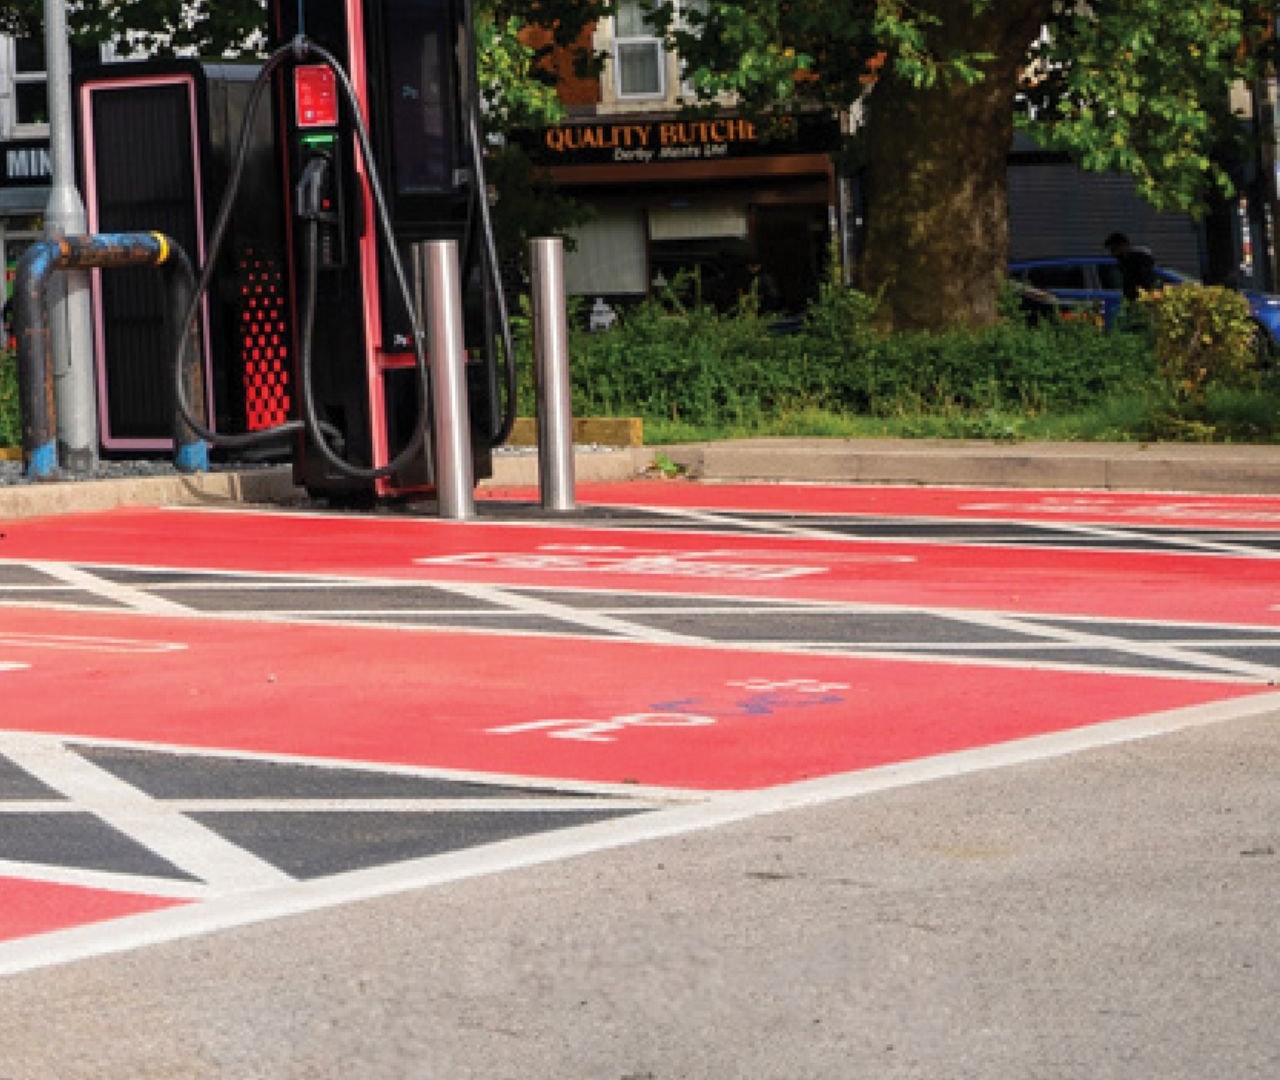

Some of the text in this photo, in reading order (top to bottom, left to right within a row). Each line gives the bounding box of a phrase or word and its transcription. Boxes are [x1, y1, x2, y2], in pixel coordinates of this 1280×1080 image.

[546, 119, 759, 152] QUALITY BUTCHE
[6, 147, 54, 179] MIN
